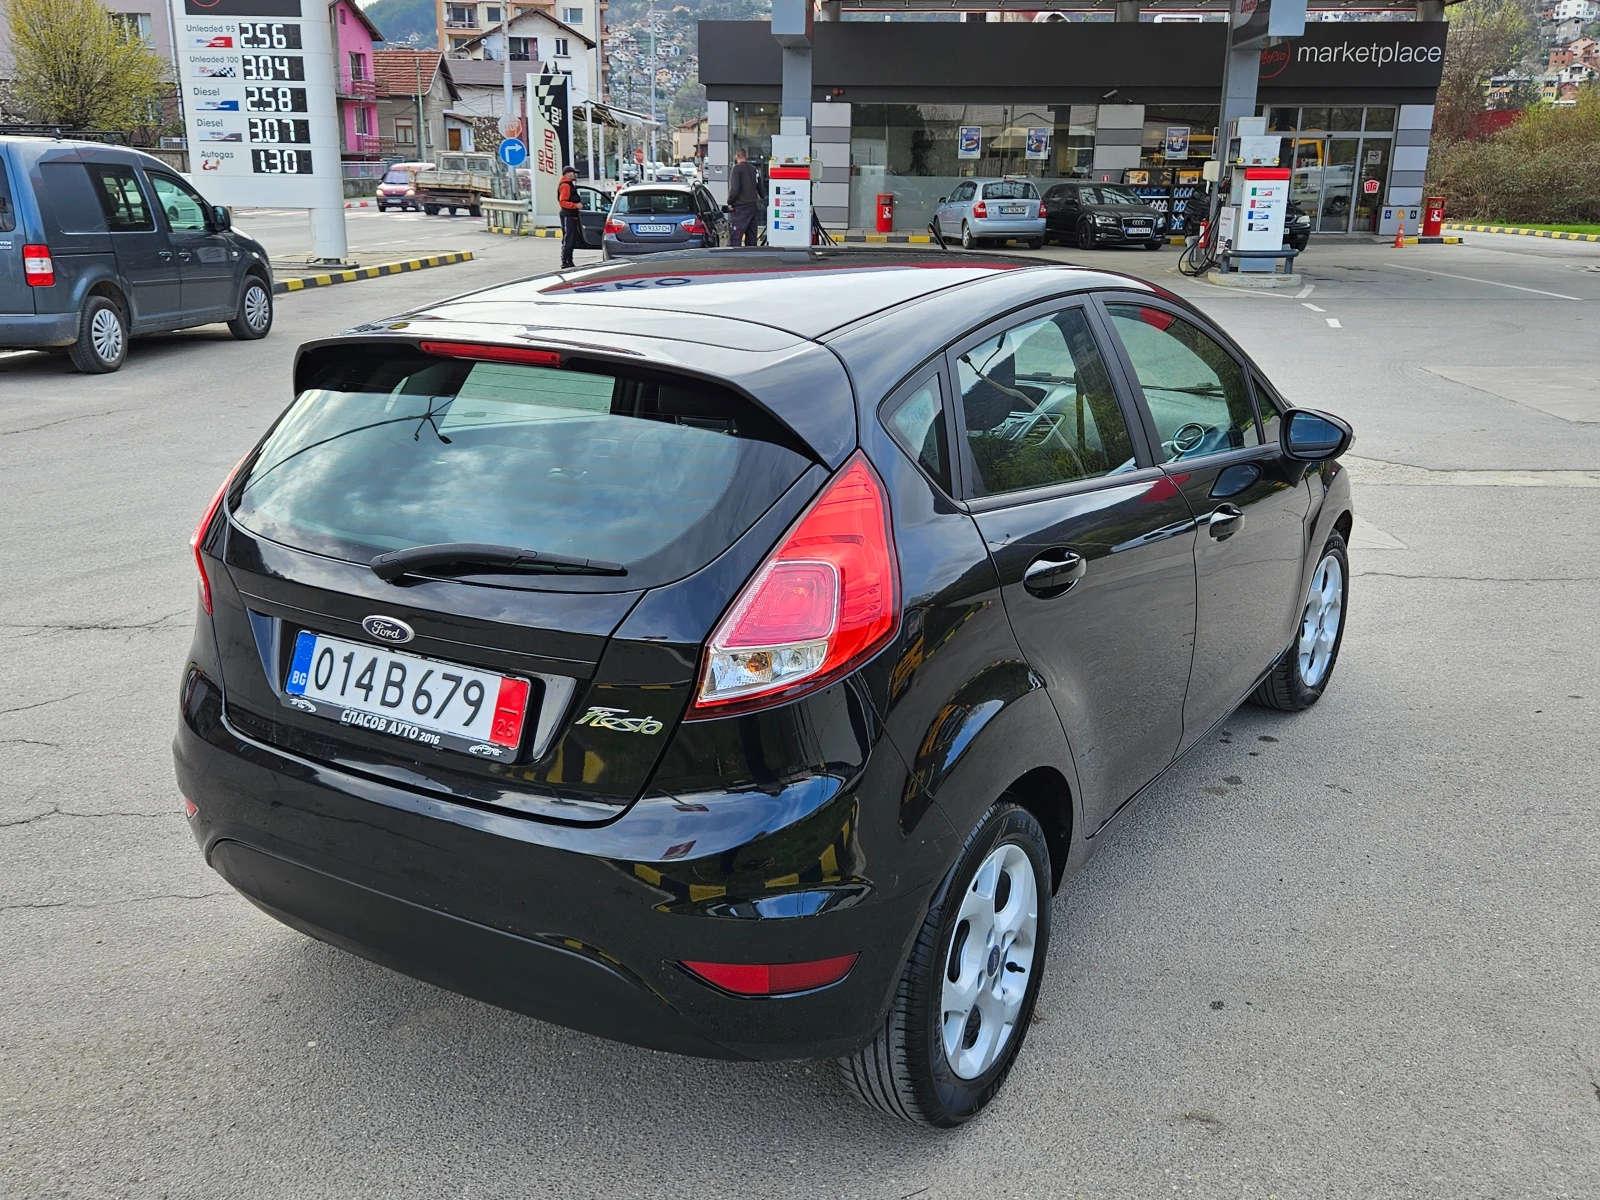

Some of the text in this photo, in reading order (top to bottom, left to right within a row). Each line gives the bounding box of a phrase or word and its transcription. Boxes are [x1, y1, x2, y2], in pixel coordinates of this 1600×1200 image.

[186, 24, 236, 33] Unleaded 95
[240, 23, 287, 49] 2.56
[189, 56, 239, 64] Unleaded 100
[1297, 41, 1442, 67] marketplace
[243, 55, 290, 80] 3.04
[193, 87, 220, 96] Diesel
[246, 87, 293, 112] 2.58
[196, 119, 223, 127] Diesel
[550, 105, 560, 127] 100
[249, 118, 296, 143] 3.07
[200, 150, 234, 159] Autogas
[260, 149, 298, 174] 1.30
[544, 128, 556, 175] racing
[371, 620, 401, 639] Ford
[291, 670, 307, 686] BG
[314, 646, 486, 727] 014B679
[340, 709, 441, 745] СПАСОВ АУТО 2016
[495, 718, 516, 739] 26
[574, 701, 664, 735] Fiesta
